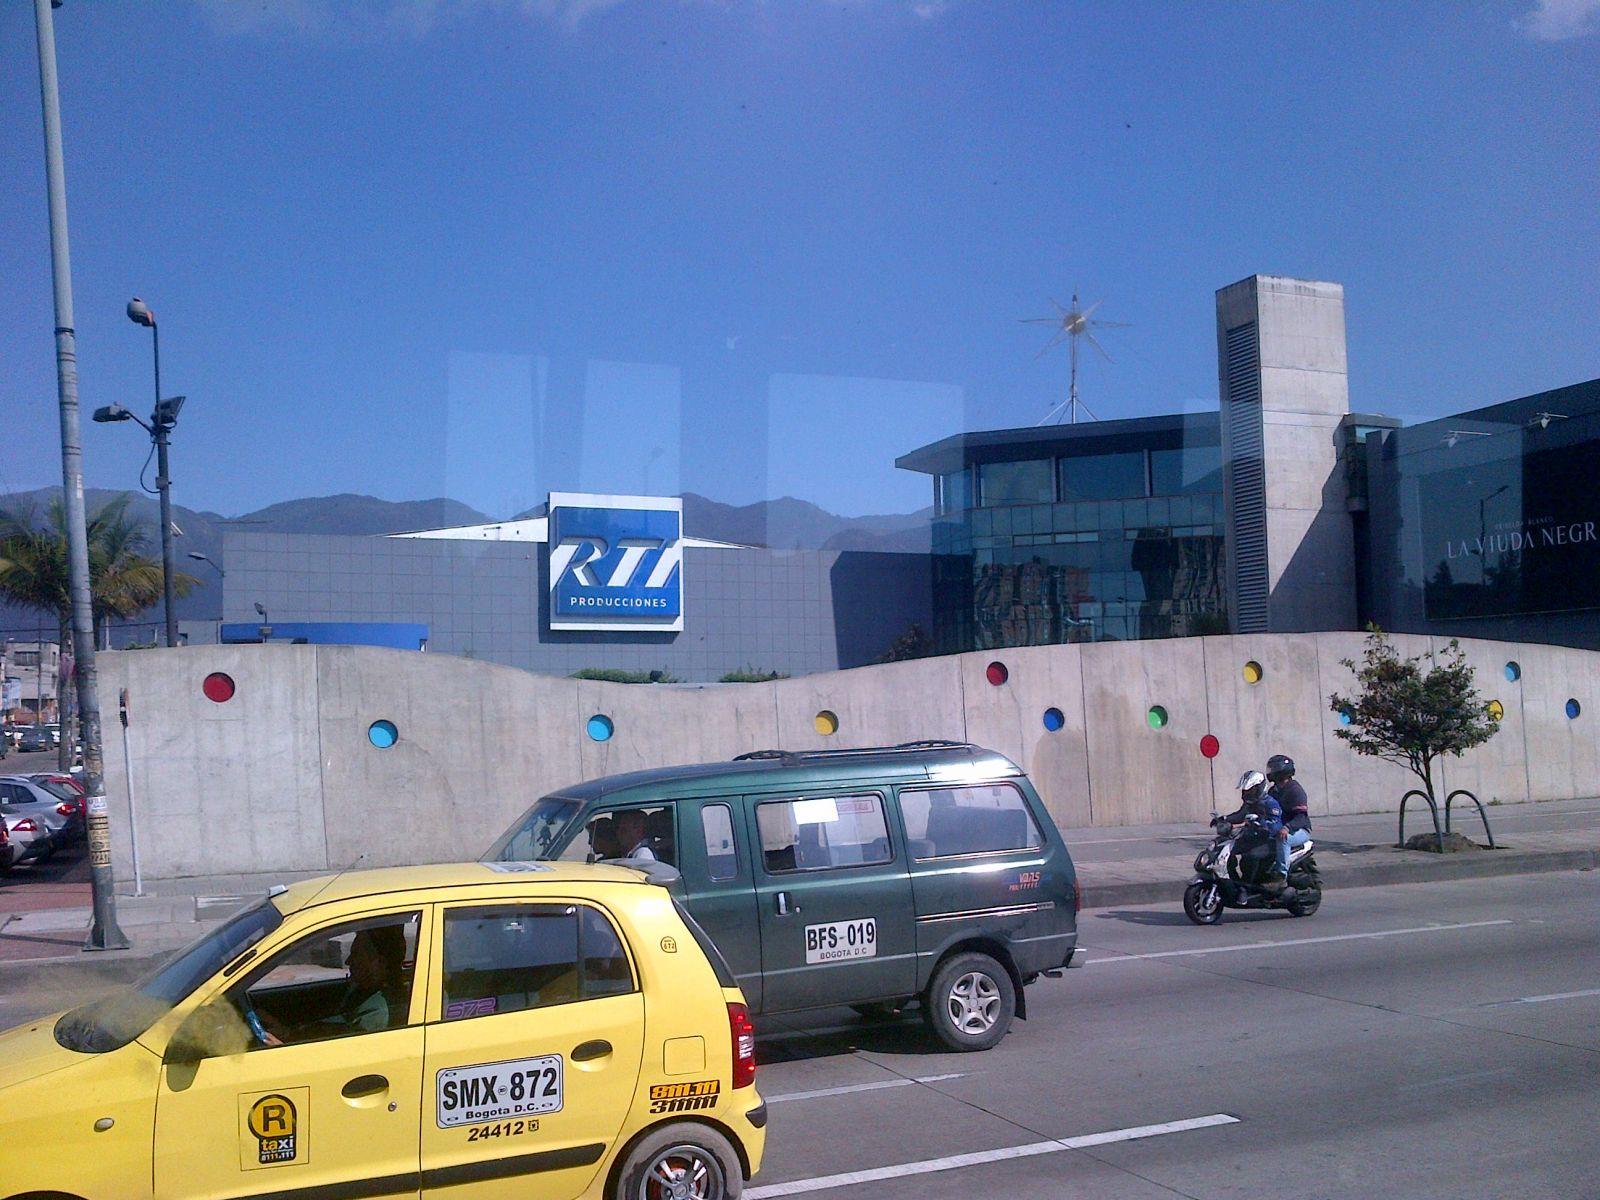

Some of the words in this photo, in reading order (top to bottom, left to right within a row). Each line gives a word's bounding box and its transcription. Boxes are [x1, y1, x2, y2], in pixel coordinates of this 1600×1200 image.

[1447, 540, 1469, 559] LA
[1476, 530, 1534, 554] VIUDA
[1542, 521, 1597, 545] NEGR
[570, 596, 667, 608] PRODUCCIONES
[820, 949, 852, 960] BOGOTA
[443, 1075, 498, 1111] SMX
[510, 1067, 557, 1101] 872
[263, 1104, 286, 1132] R
[465, 1107, 510, 1120] Bogota
[514, 1103, 539, 1113] D.C.
[467, 1121, 525, 1142] 24412
[261, 1136, 293, 1150] taxi
